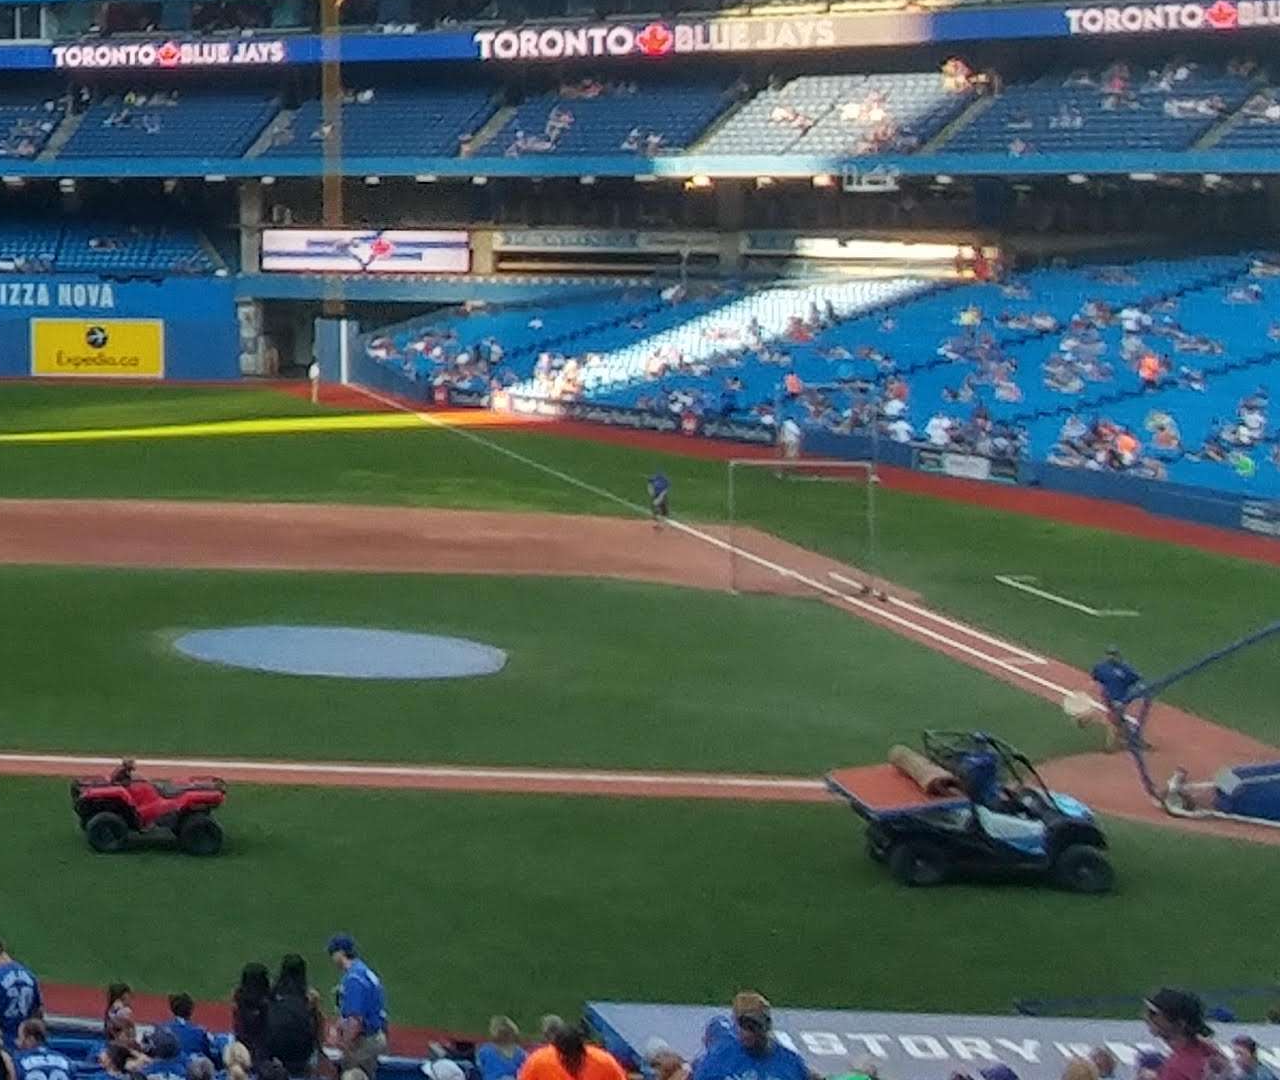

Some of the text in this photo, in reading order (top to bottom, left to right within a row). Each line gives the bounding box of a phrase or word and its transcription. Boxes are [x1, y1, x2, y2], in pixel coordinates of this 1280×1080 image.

[1065, 6, 1204, 34] TORONTO
[473, 21, 835, 58] TORONTO BLUE JAYS
[52, 41, 285, 67] TORONTO BLUE JAYS
[58, 283, 114, 308] NOVA
[56, 351, 139, 368] Expedia.ca
[5, 985, 34, 1017] 20
